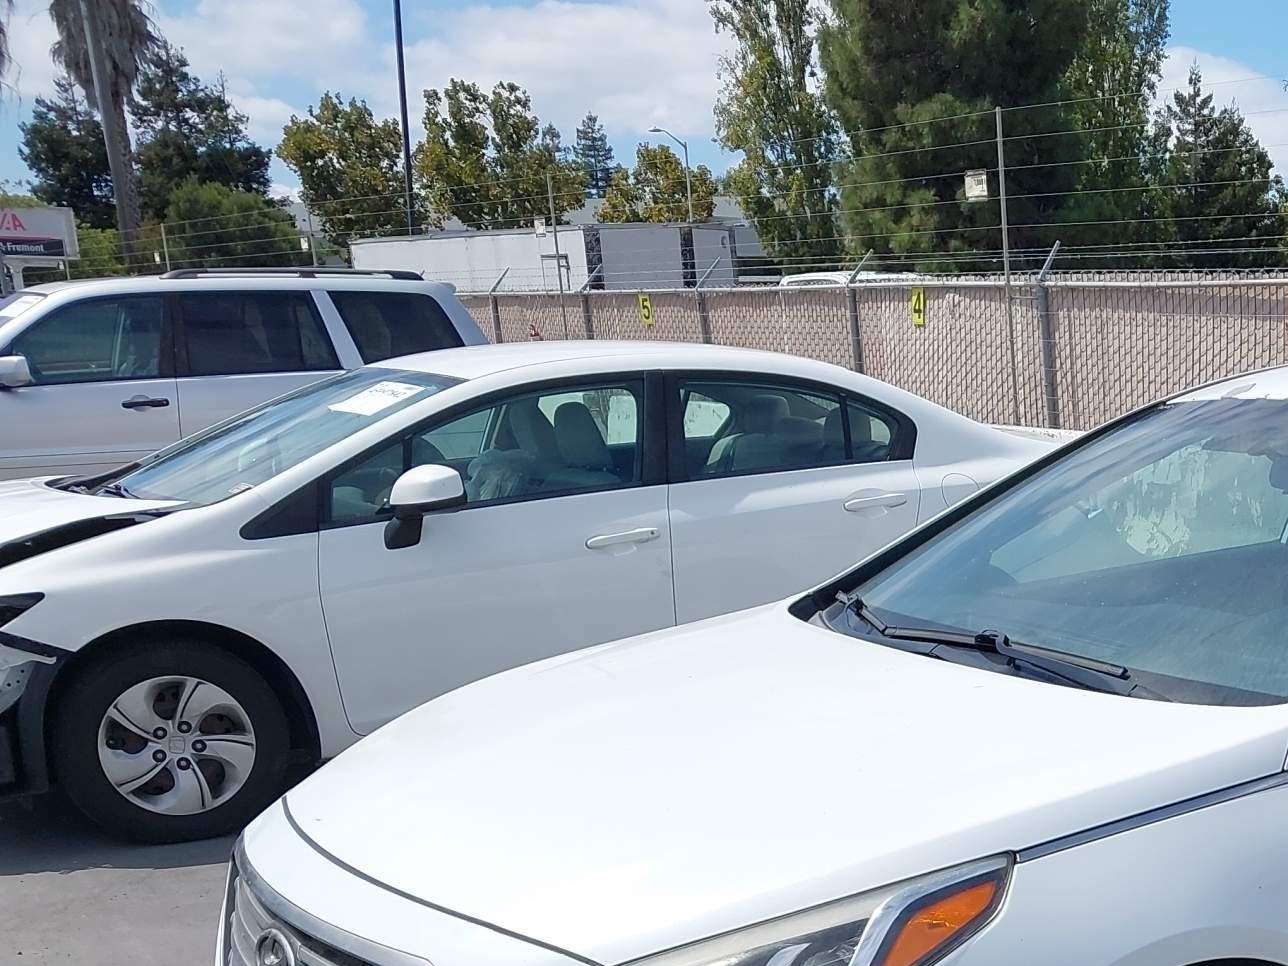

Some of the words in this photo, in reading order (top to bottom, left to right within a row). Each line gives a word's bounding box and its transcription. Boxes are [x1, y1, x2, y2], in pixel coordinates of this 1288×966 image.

[6, 242, 45, 252] Fremont
[641, 297, 651, 320] 5
[913, 291, 922, 320] 4
